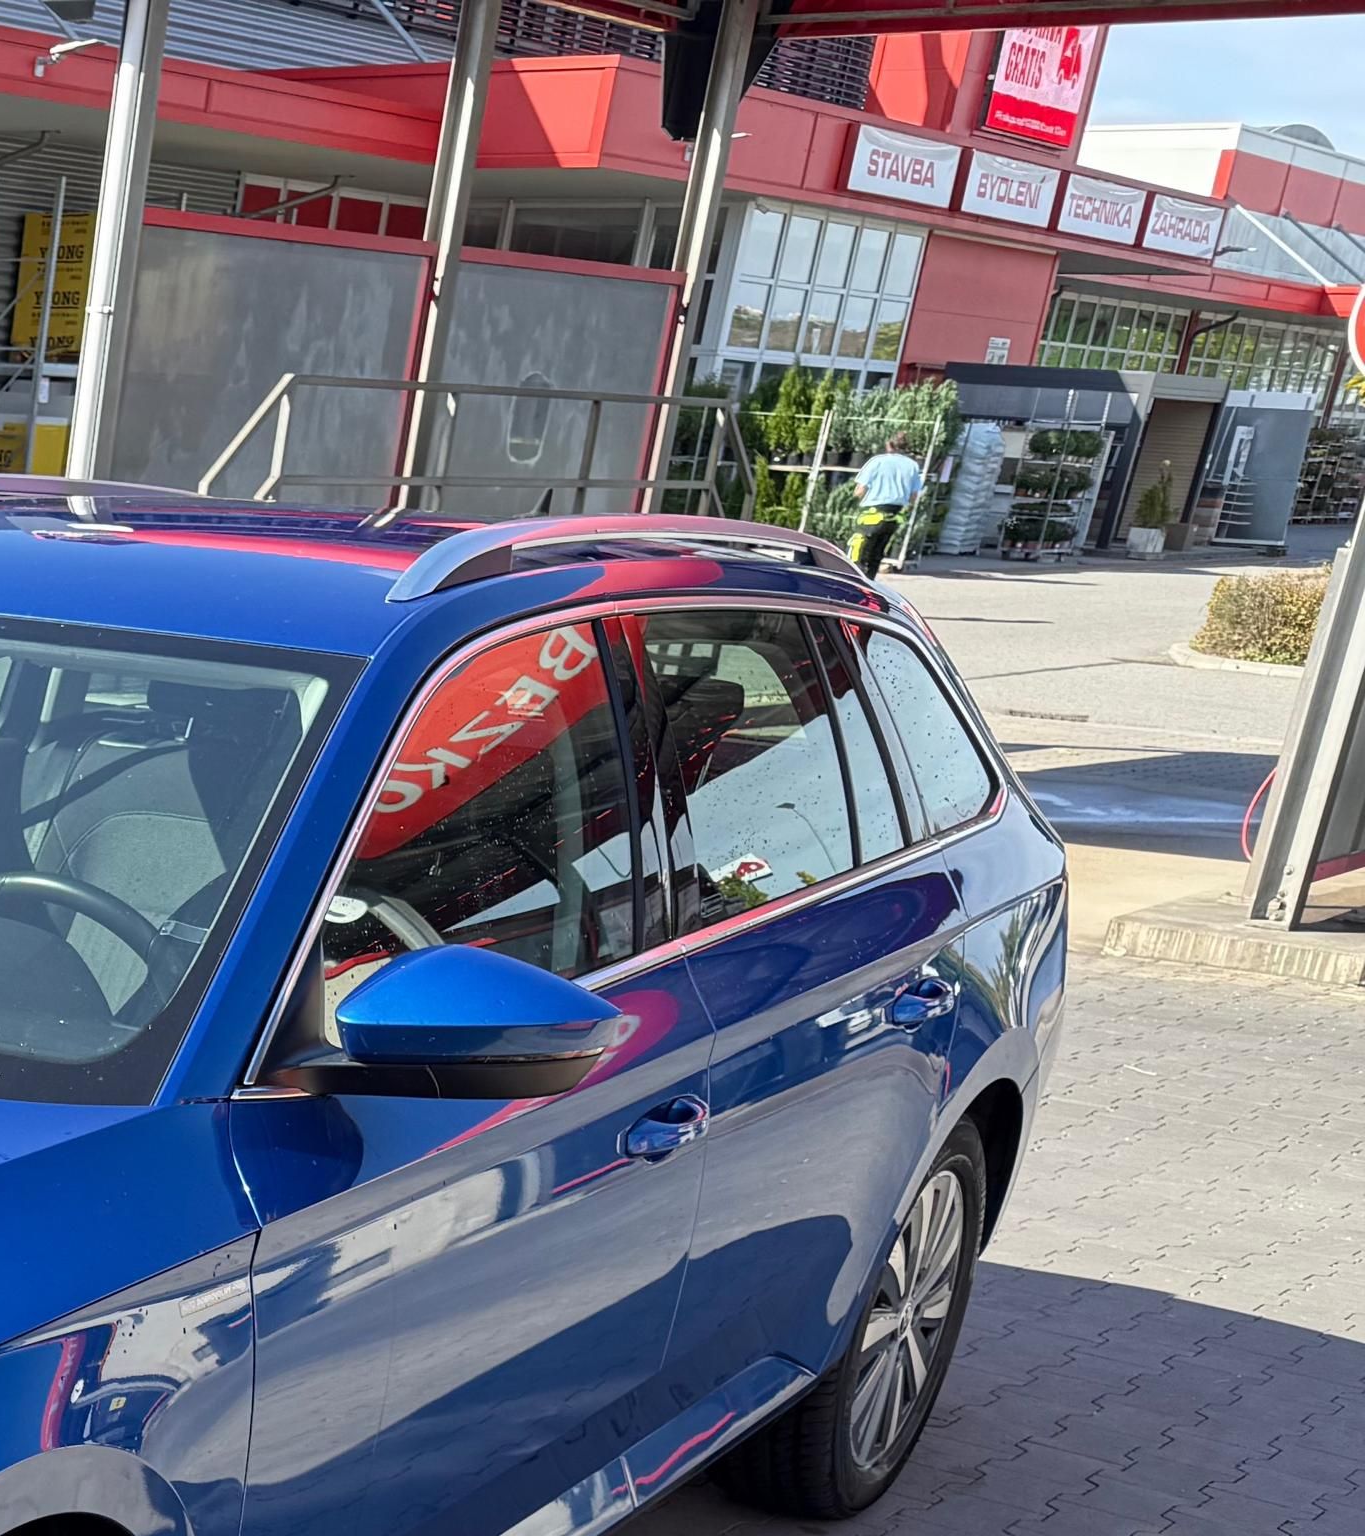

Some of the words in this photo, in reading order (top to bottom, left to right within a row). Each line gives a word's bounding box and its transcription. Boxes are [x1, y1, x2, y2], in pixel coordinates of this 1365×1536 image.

[1004, 38, 1046, 89] GRÁTIS
[867, 149, 936, 188] STAVBA
[976, 173, 1047, 210] BYDLENÍ
[1068, 193, 1132, 229] TECHNIKA
[1150, 211, 1210, 245] ZAHRADA
[39, 245, 85, 260] YONG
[34, 291, 80, 306] YONG
[29, 335, 75, 349] YONG
